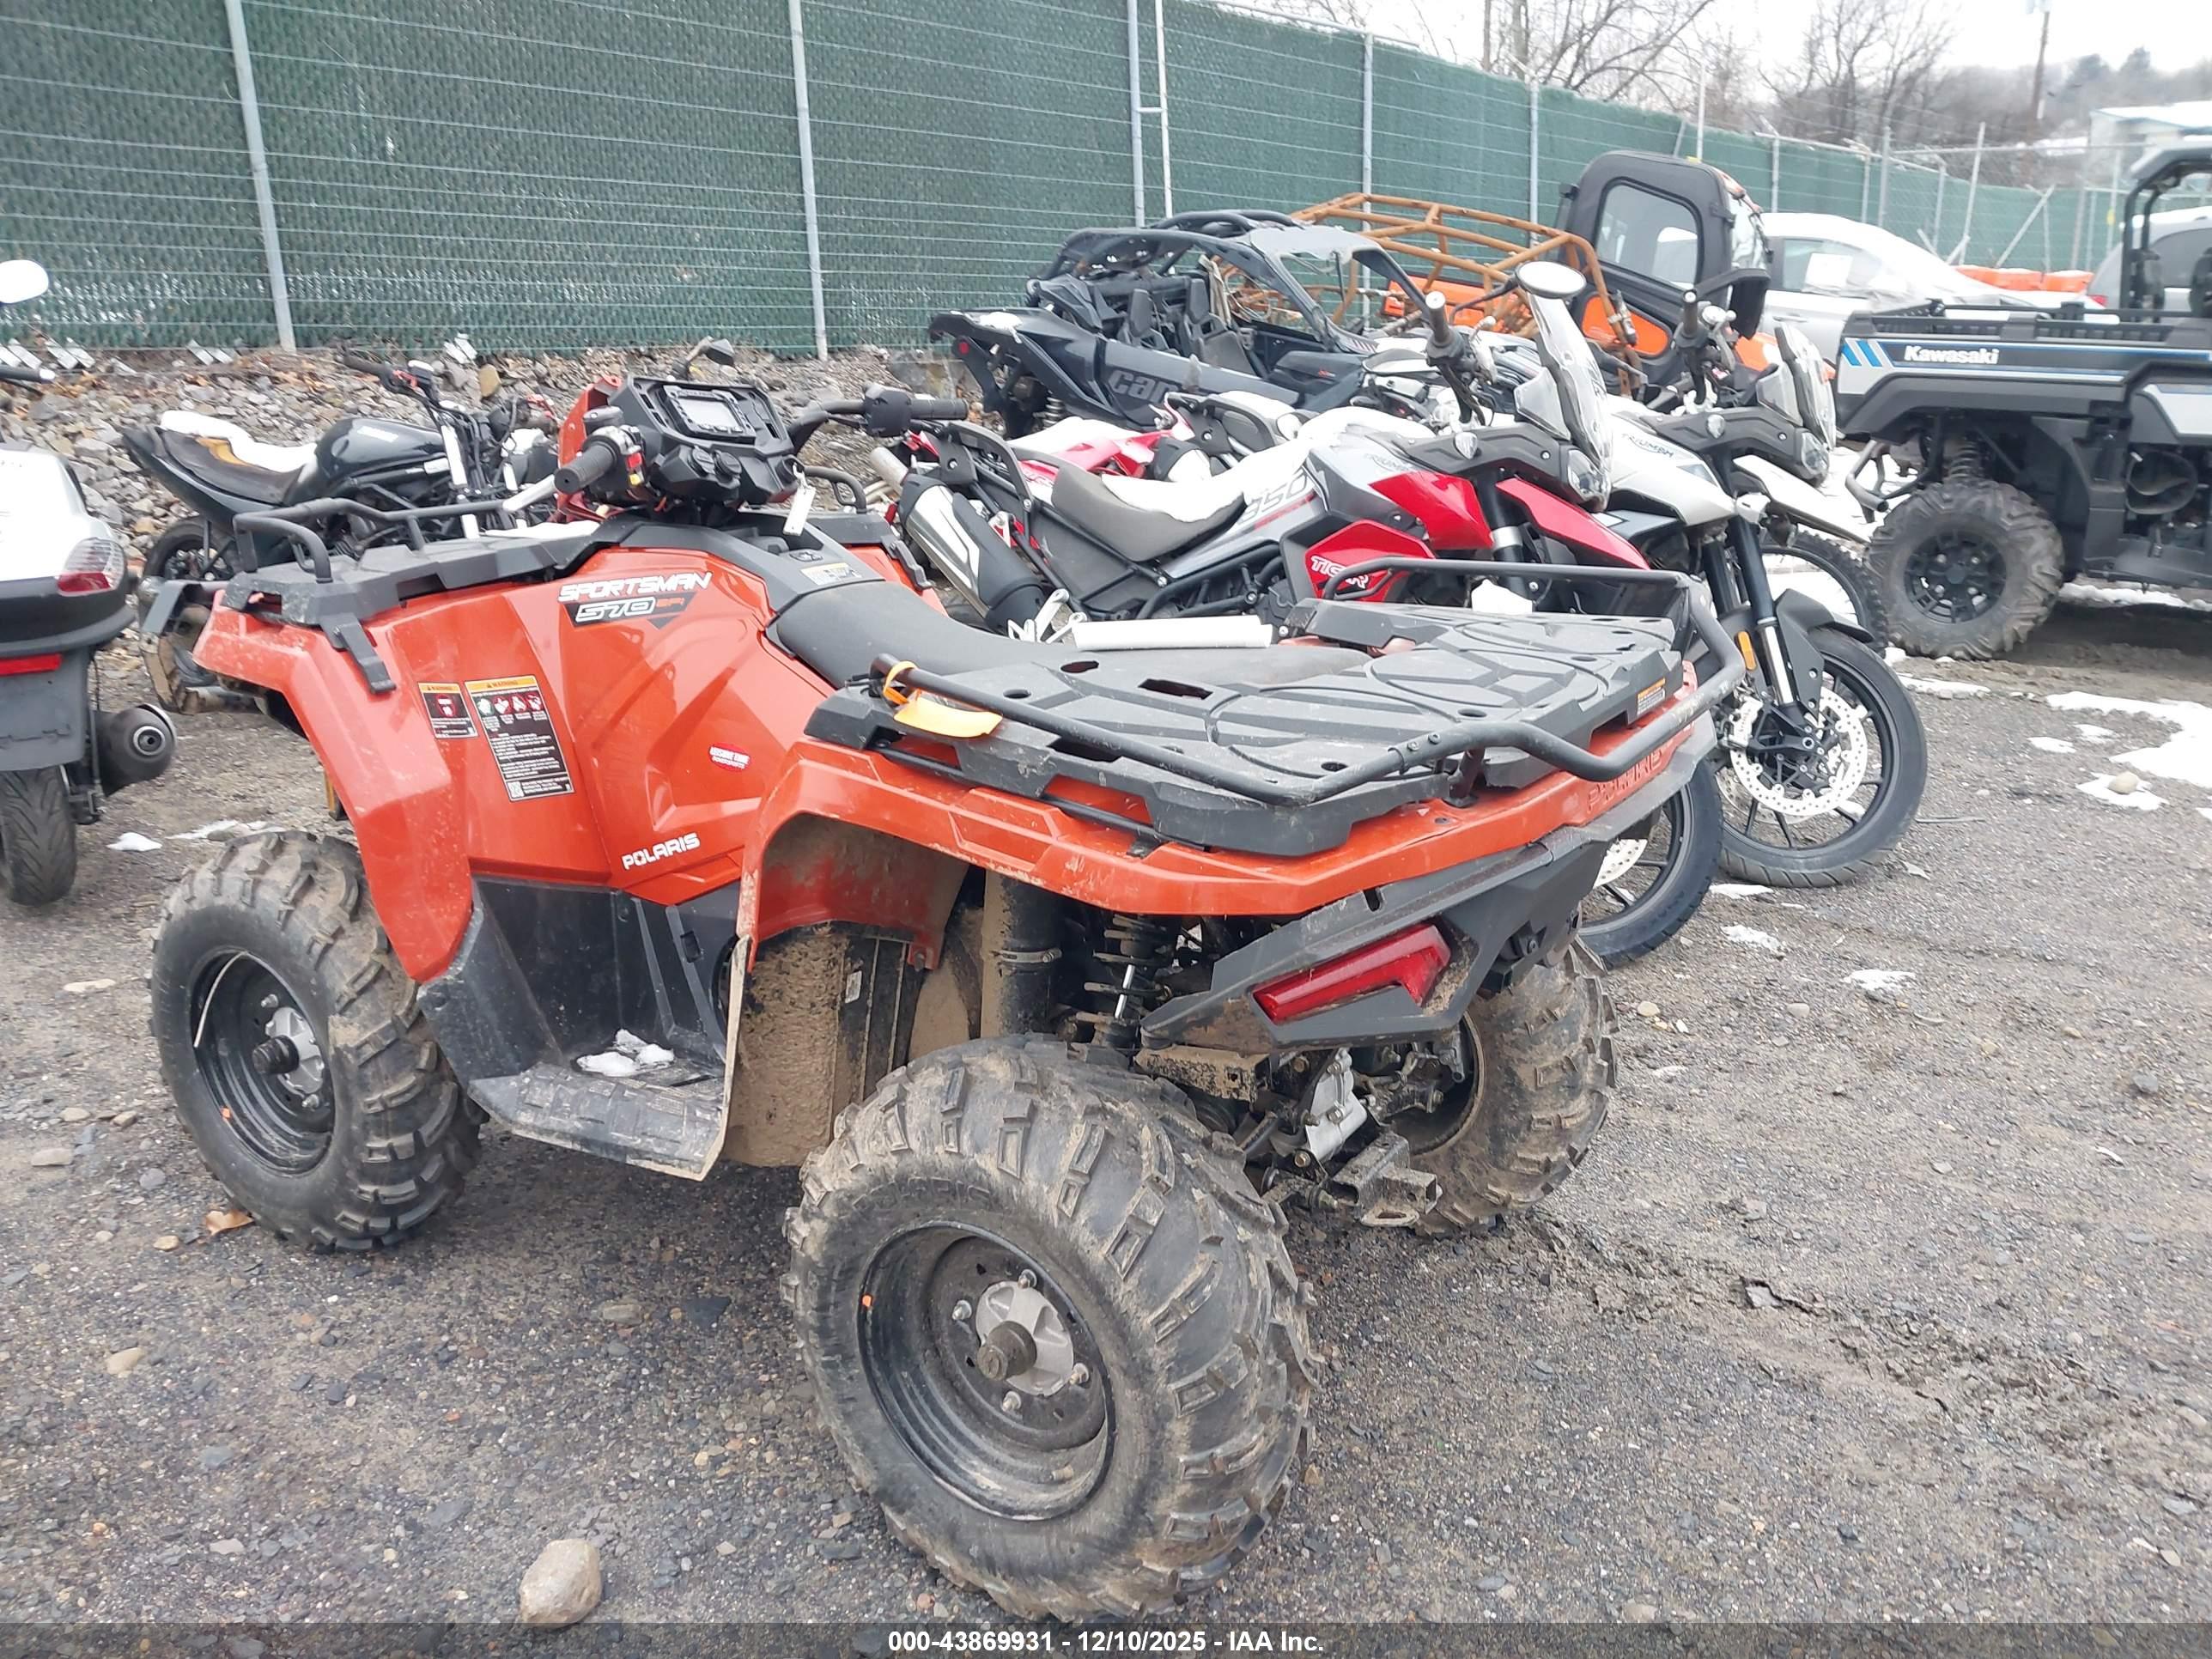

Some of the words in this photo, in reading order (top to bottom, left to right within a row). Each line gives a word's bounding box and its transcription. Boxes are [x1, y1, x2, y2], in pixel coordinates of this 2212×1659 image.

[1904, 345, 2000, 364] Kawasaki
[558, 571, 713, 602] SPORTSMAN
[575, 596, 656, 623] 570
[621, 832, 701, 871] POLARIS
